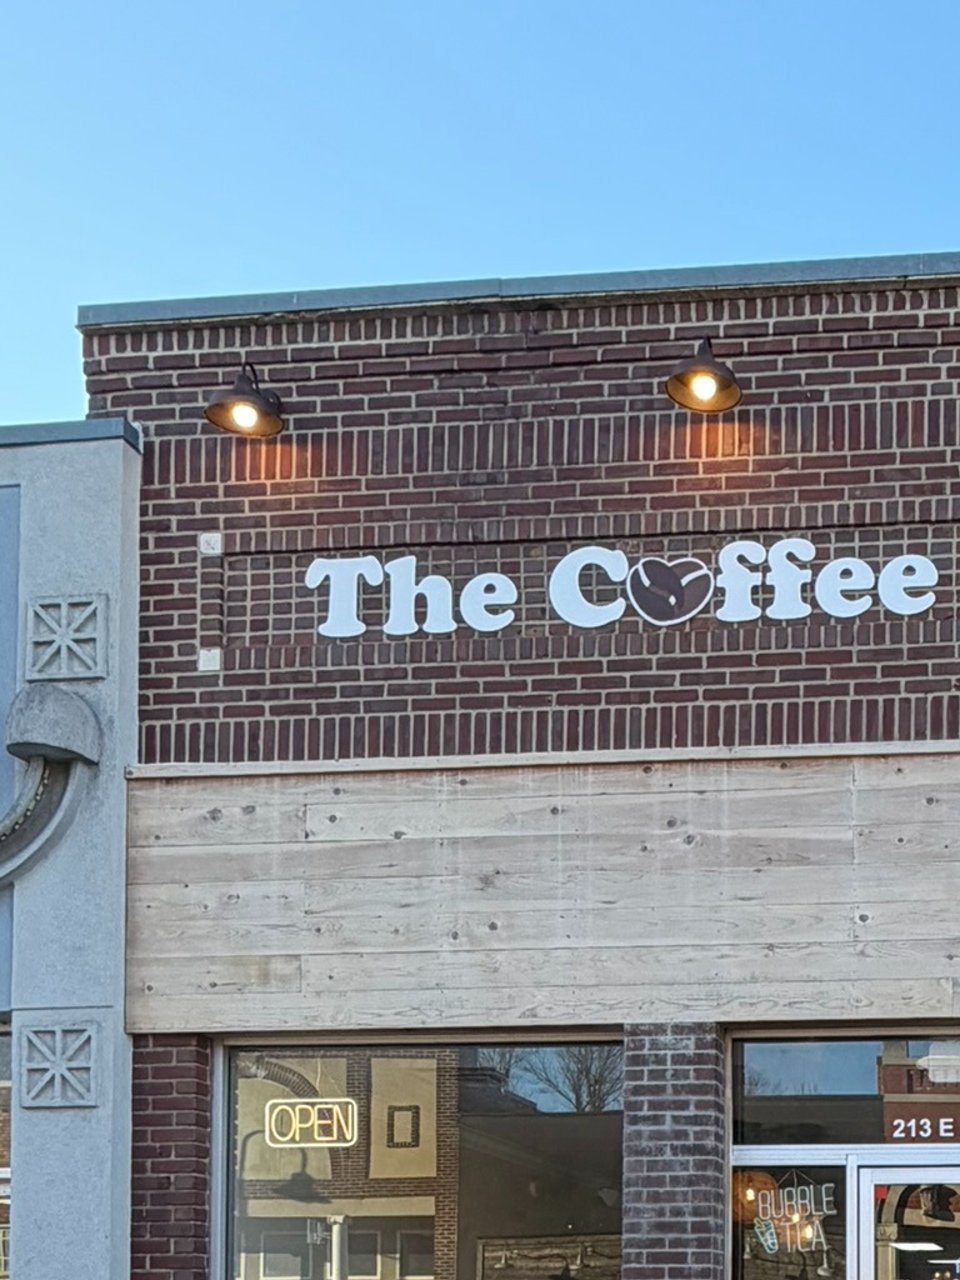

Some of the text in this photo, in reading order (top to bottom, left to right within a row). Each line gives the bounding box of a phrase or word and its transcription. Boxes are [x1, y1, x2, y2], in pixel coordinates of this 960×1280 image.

[304, 554, 518, 638] The
[269, 1103, 354, 1143] OPEN
[892, 1118, 932, 1138] 213
[939, 1118, 955, 1138] E
[758, 1183, 838, 1220] BUBBLE
